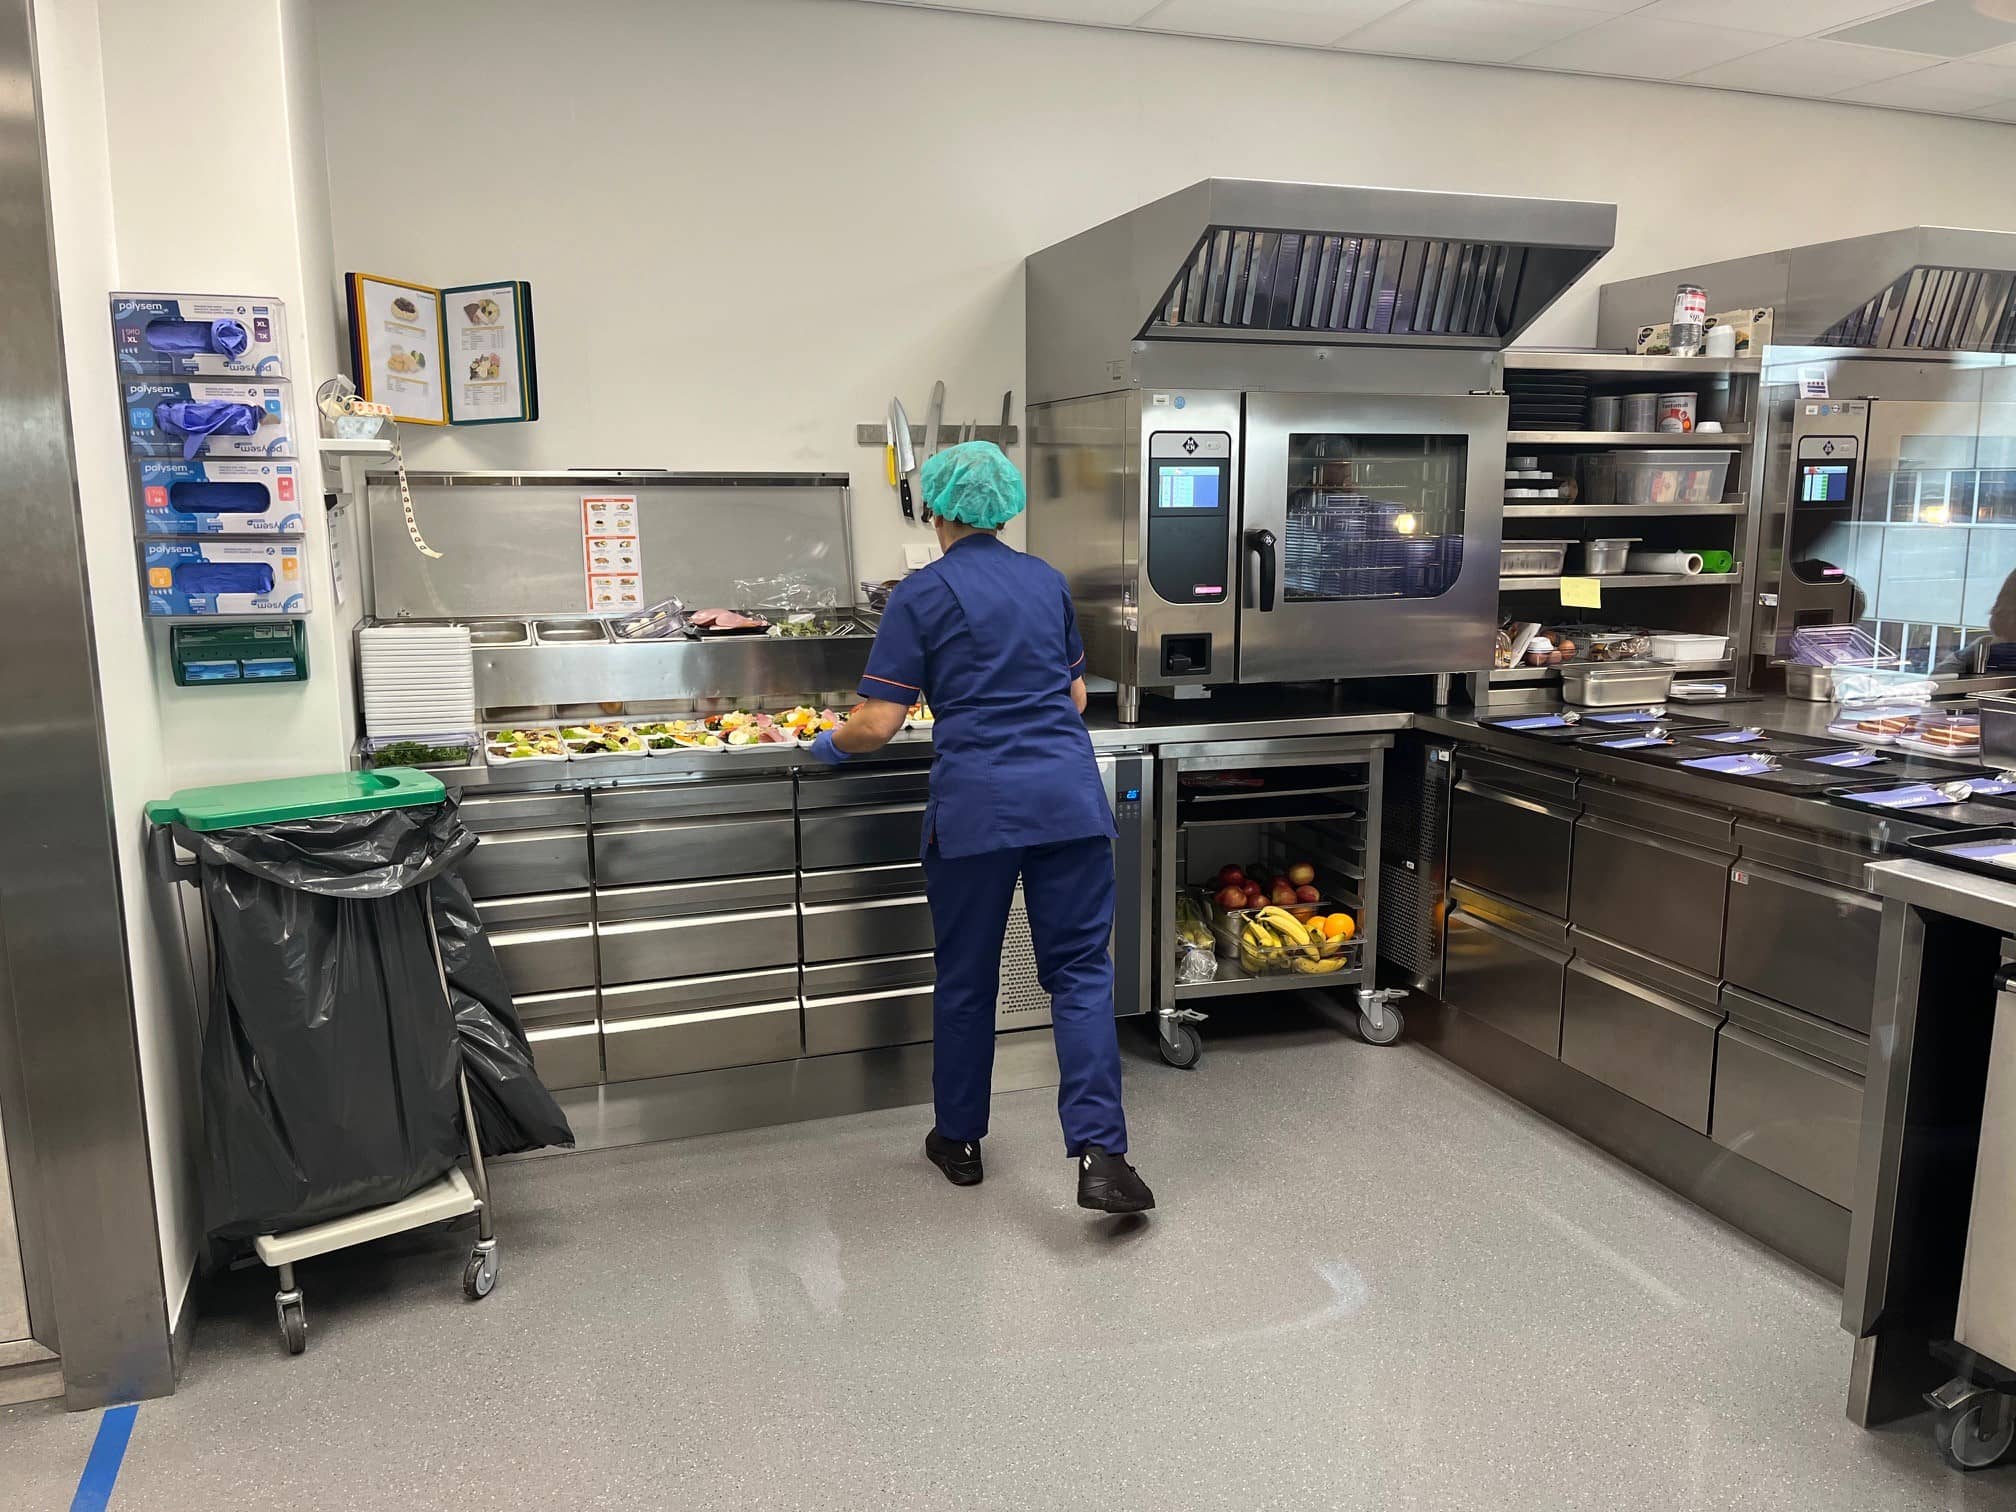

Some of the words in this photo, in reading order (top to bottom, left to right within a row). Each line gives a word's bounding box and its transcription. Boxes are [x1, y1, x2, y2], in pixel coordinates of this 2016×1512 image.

[119, 302, 163, 312] polysem
[130, 385, 174, 394] polysem
[145, 463, 188, 473] polysem
[149, 545, 192, 554] polysem
